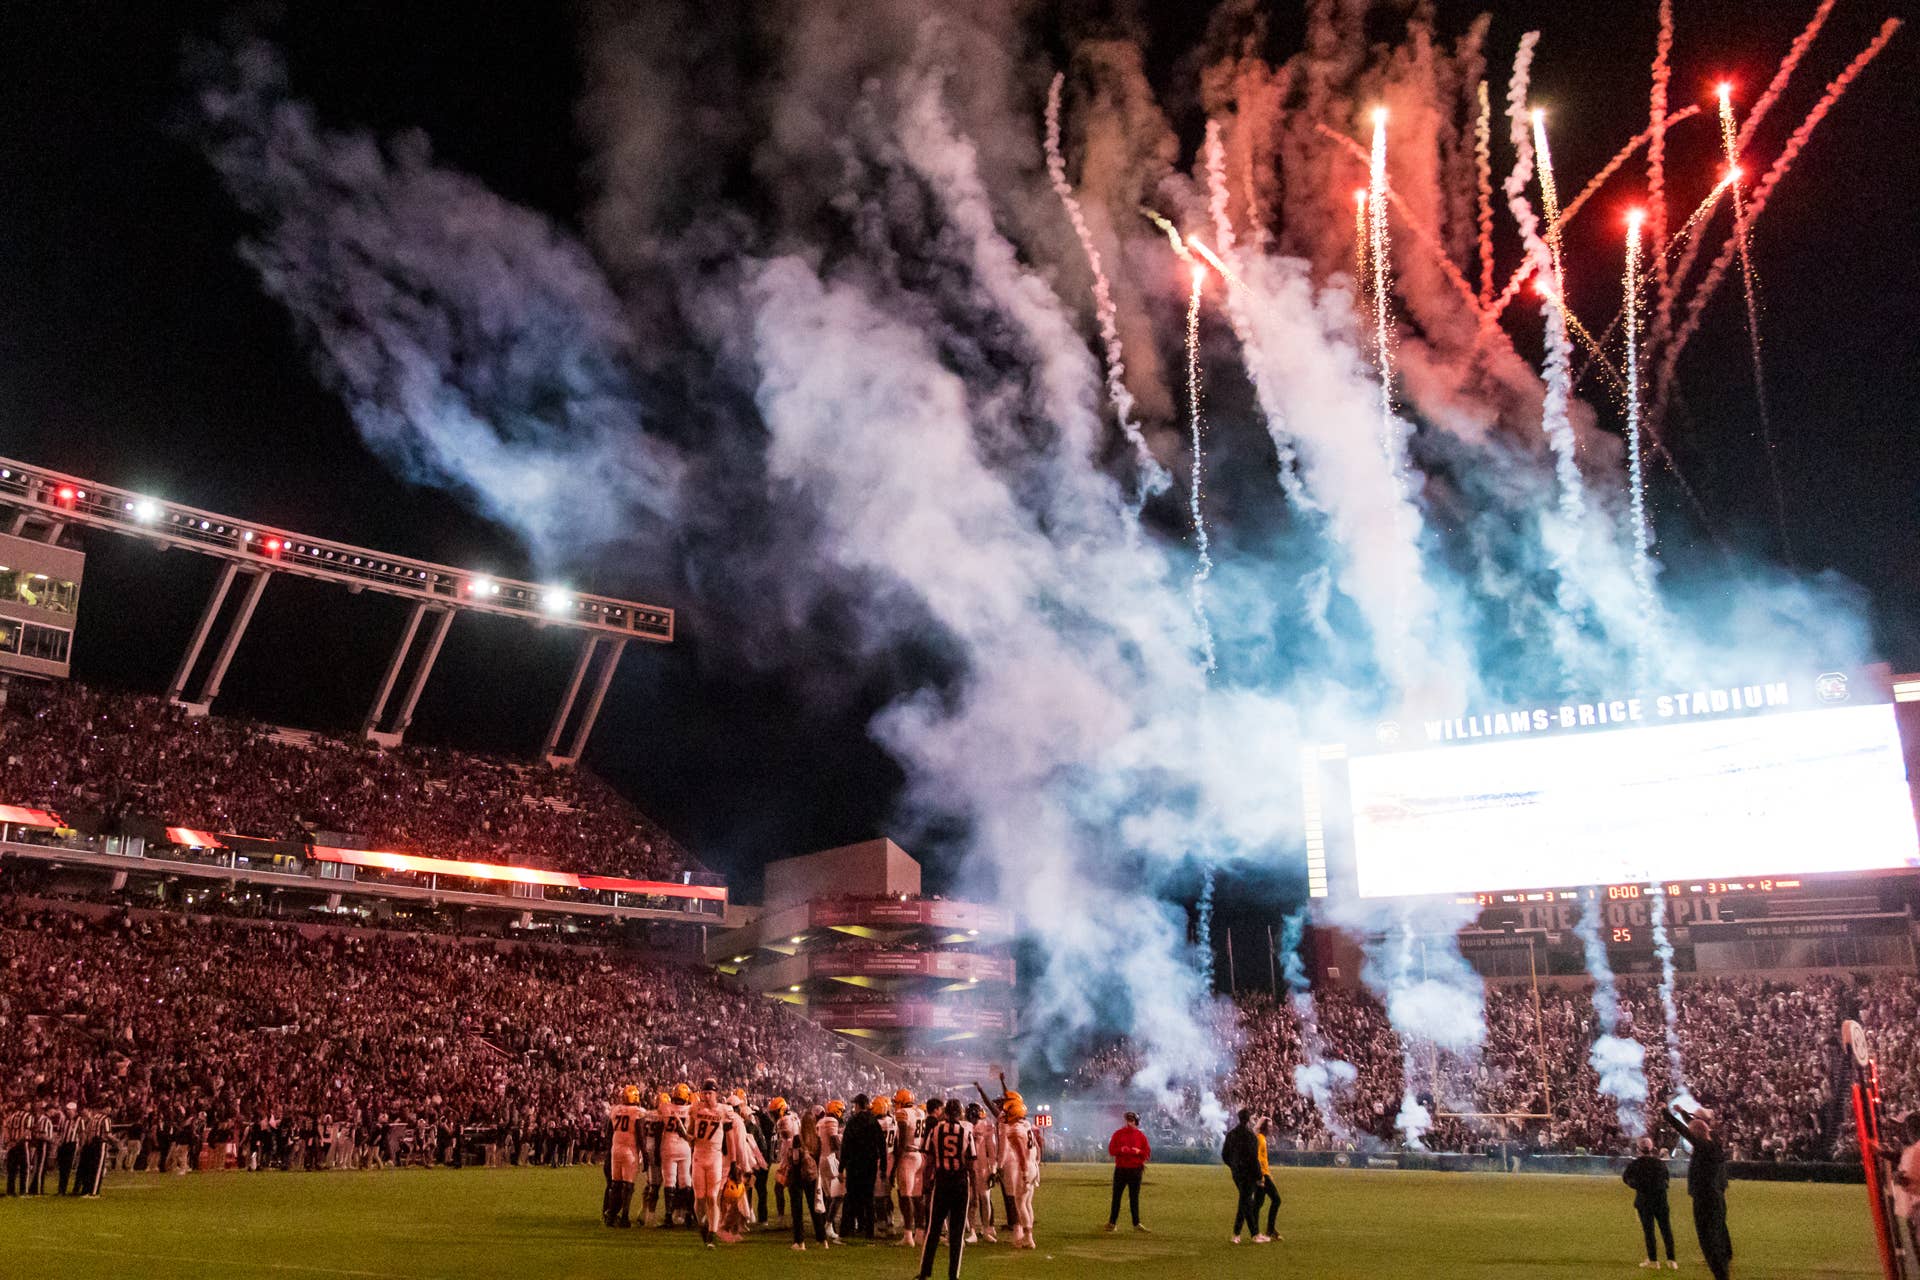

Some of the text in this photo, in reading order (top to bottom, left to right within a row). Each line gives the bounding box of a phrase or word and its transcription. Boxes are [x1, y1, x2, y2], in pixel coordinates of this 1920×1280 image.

[1424, 682, 1790, 742] WILLIAMS-BRICE STADIUM
[1668, 884, 1680, 896] 18
[1709, 883, 1717, 894] 3
[1760, 880, 1772, 891] 12
[1546, 892, 1554, 902] 3
[1608, 886, 1639, 899] 0:00
[1479, 895, 1493, 905] 21
[1519, 898, 1721, 930] THE OCPIT
[1613, 928, 1631, 942] 25
[1794, 923, 1849, 934] CHAMPIONS
[614, 1114, 630, 1132] 70
[697, 1120, 720, 1140] 87
[943, 1135, 958, 1157] S
